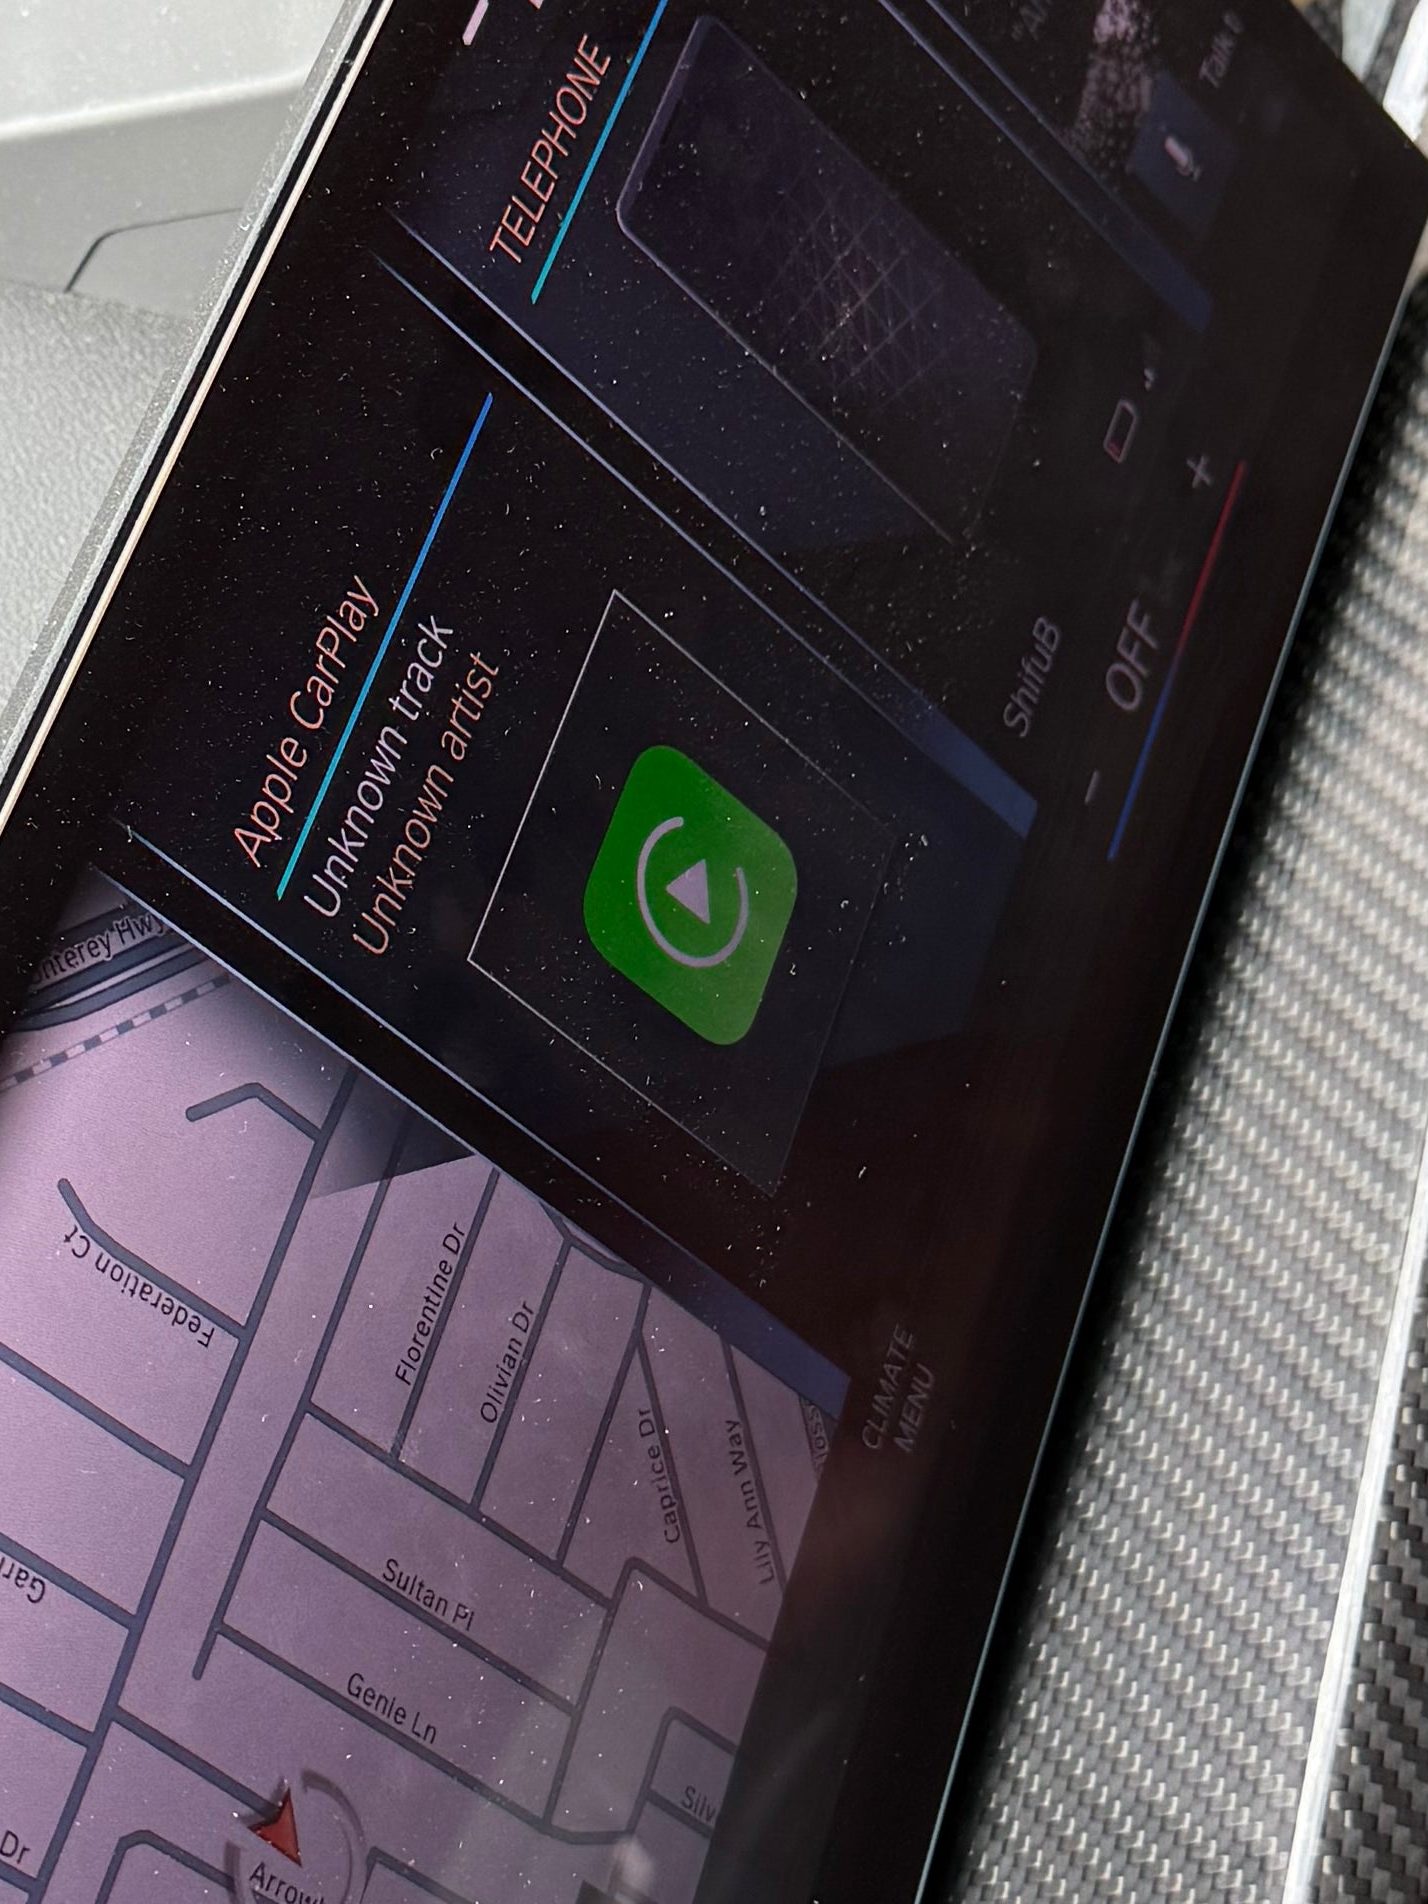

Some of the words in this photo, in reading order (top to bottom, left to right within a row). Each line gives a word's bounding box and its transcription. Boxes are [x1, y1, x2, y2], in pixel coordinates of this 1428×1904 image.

[488, 33, 611, 264] TELEPHONE
[1002, 615, 1061, 739] ShifuB
[1105, 597, 1160, 712] OFF
[234, 735, 308, 869] Apple
[289, 575, 380, 730] CarPlay
[303, 725, 408, 919] Unknown
[388, 614, 454, 722] track
[352, 762, 454, 956] Unknown
[441, 650, 499, 761] artist
[63, 1225, 91, 1258] Ct
[94, 1252, 215, 1348] Federation
[394, 1260, 453, 1386] Florentine
[442, 1222, 466, 1256] Dr
[479, 1335, 523, 1425] Olivian
[511, 1300, 535, 1334] Dr
[861, 1322, 914, 1450] CLIMATE
[893, 1361, 936, 1453] MENU
[637, 1407, 656, 1438] Dr
[724, 1417, 748, 1476] Way
[647, 1446, 681, 1544] Caprice
[739, 1479, 763, 1531] Ann
[382, 1557, 448, 1617] Sultan
[452, 1602, 475, 1631] Pl
[346, 1672, 407, 1725] Genie
[411, 1711, 437, 1744] Ln
